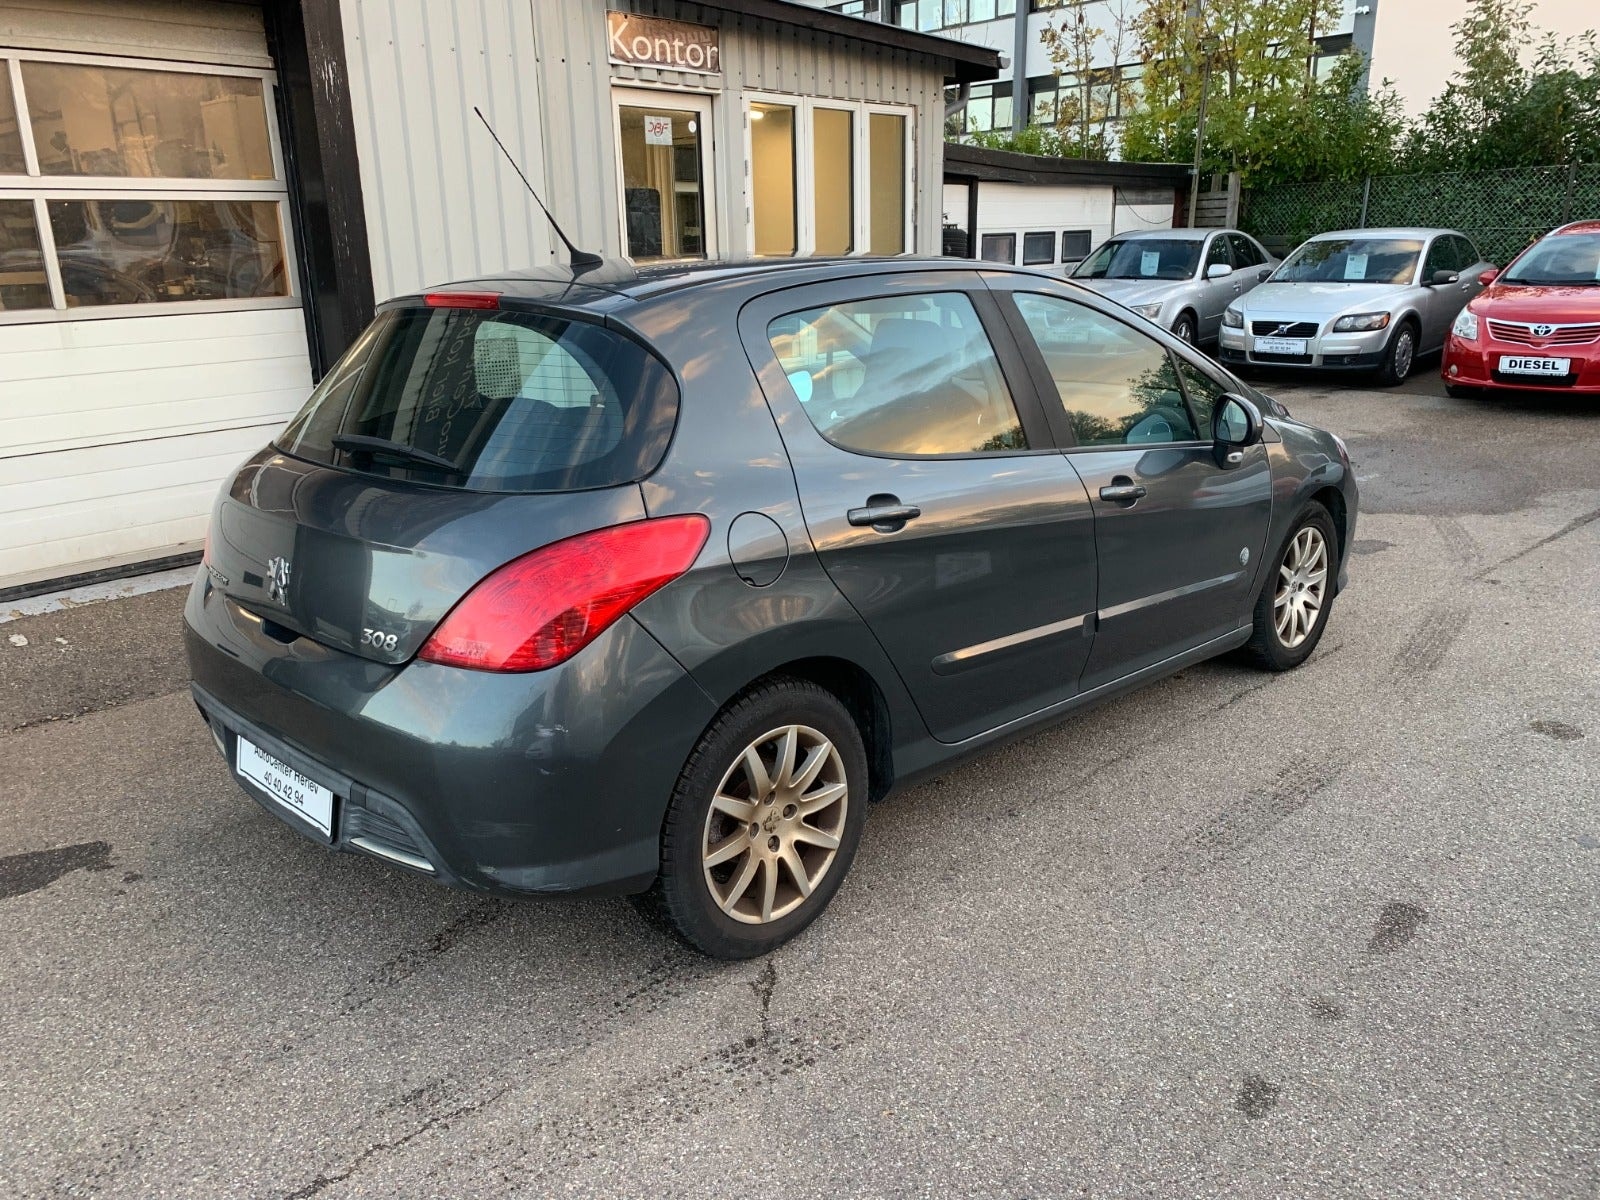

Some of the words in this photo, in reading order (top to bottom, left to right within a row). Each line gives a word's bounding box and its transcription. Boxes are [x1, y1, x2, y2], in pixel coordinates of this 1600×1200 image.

[608, 20, 718, 69] Kontor
[1508, 359, 1559, 370] DIESEL
[360, 627, 398, 652] 308
[264, 771, 272, 786] 40
[273, 777, 282, 792] 40
[283, 784, 292, 800] 42
[294, 790, 304, 806] 94
